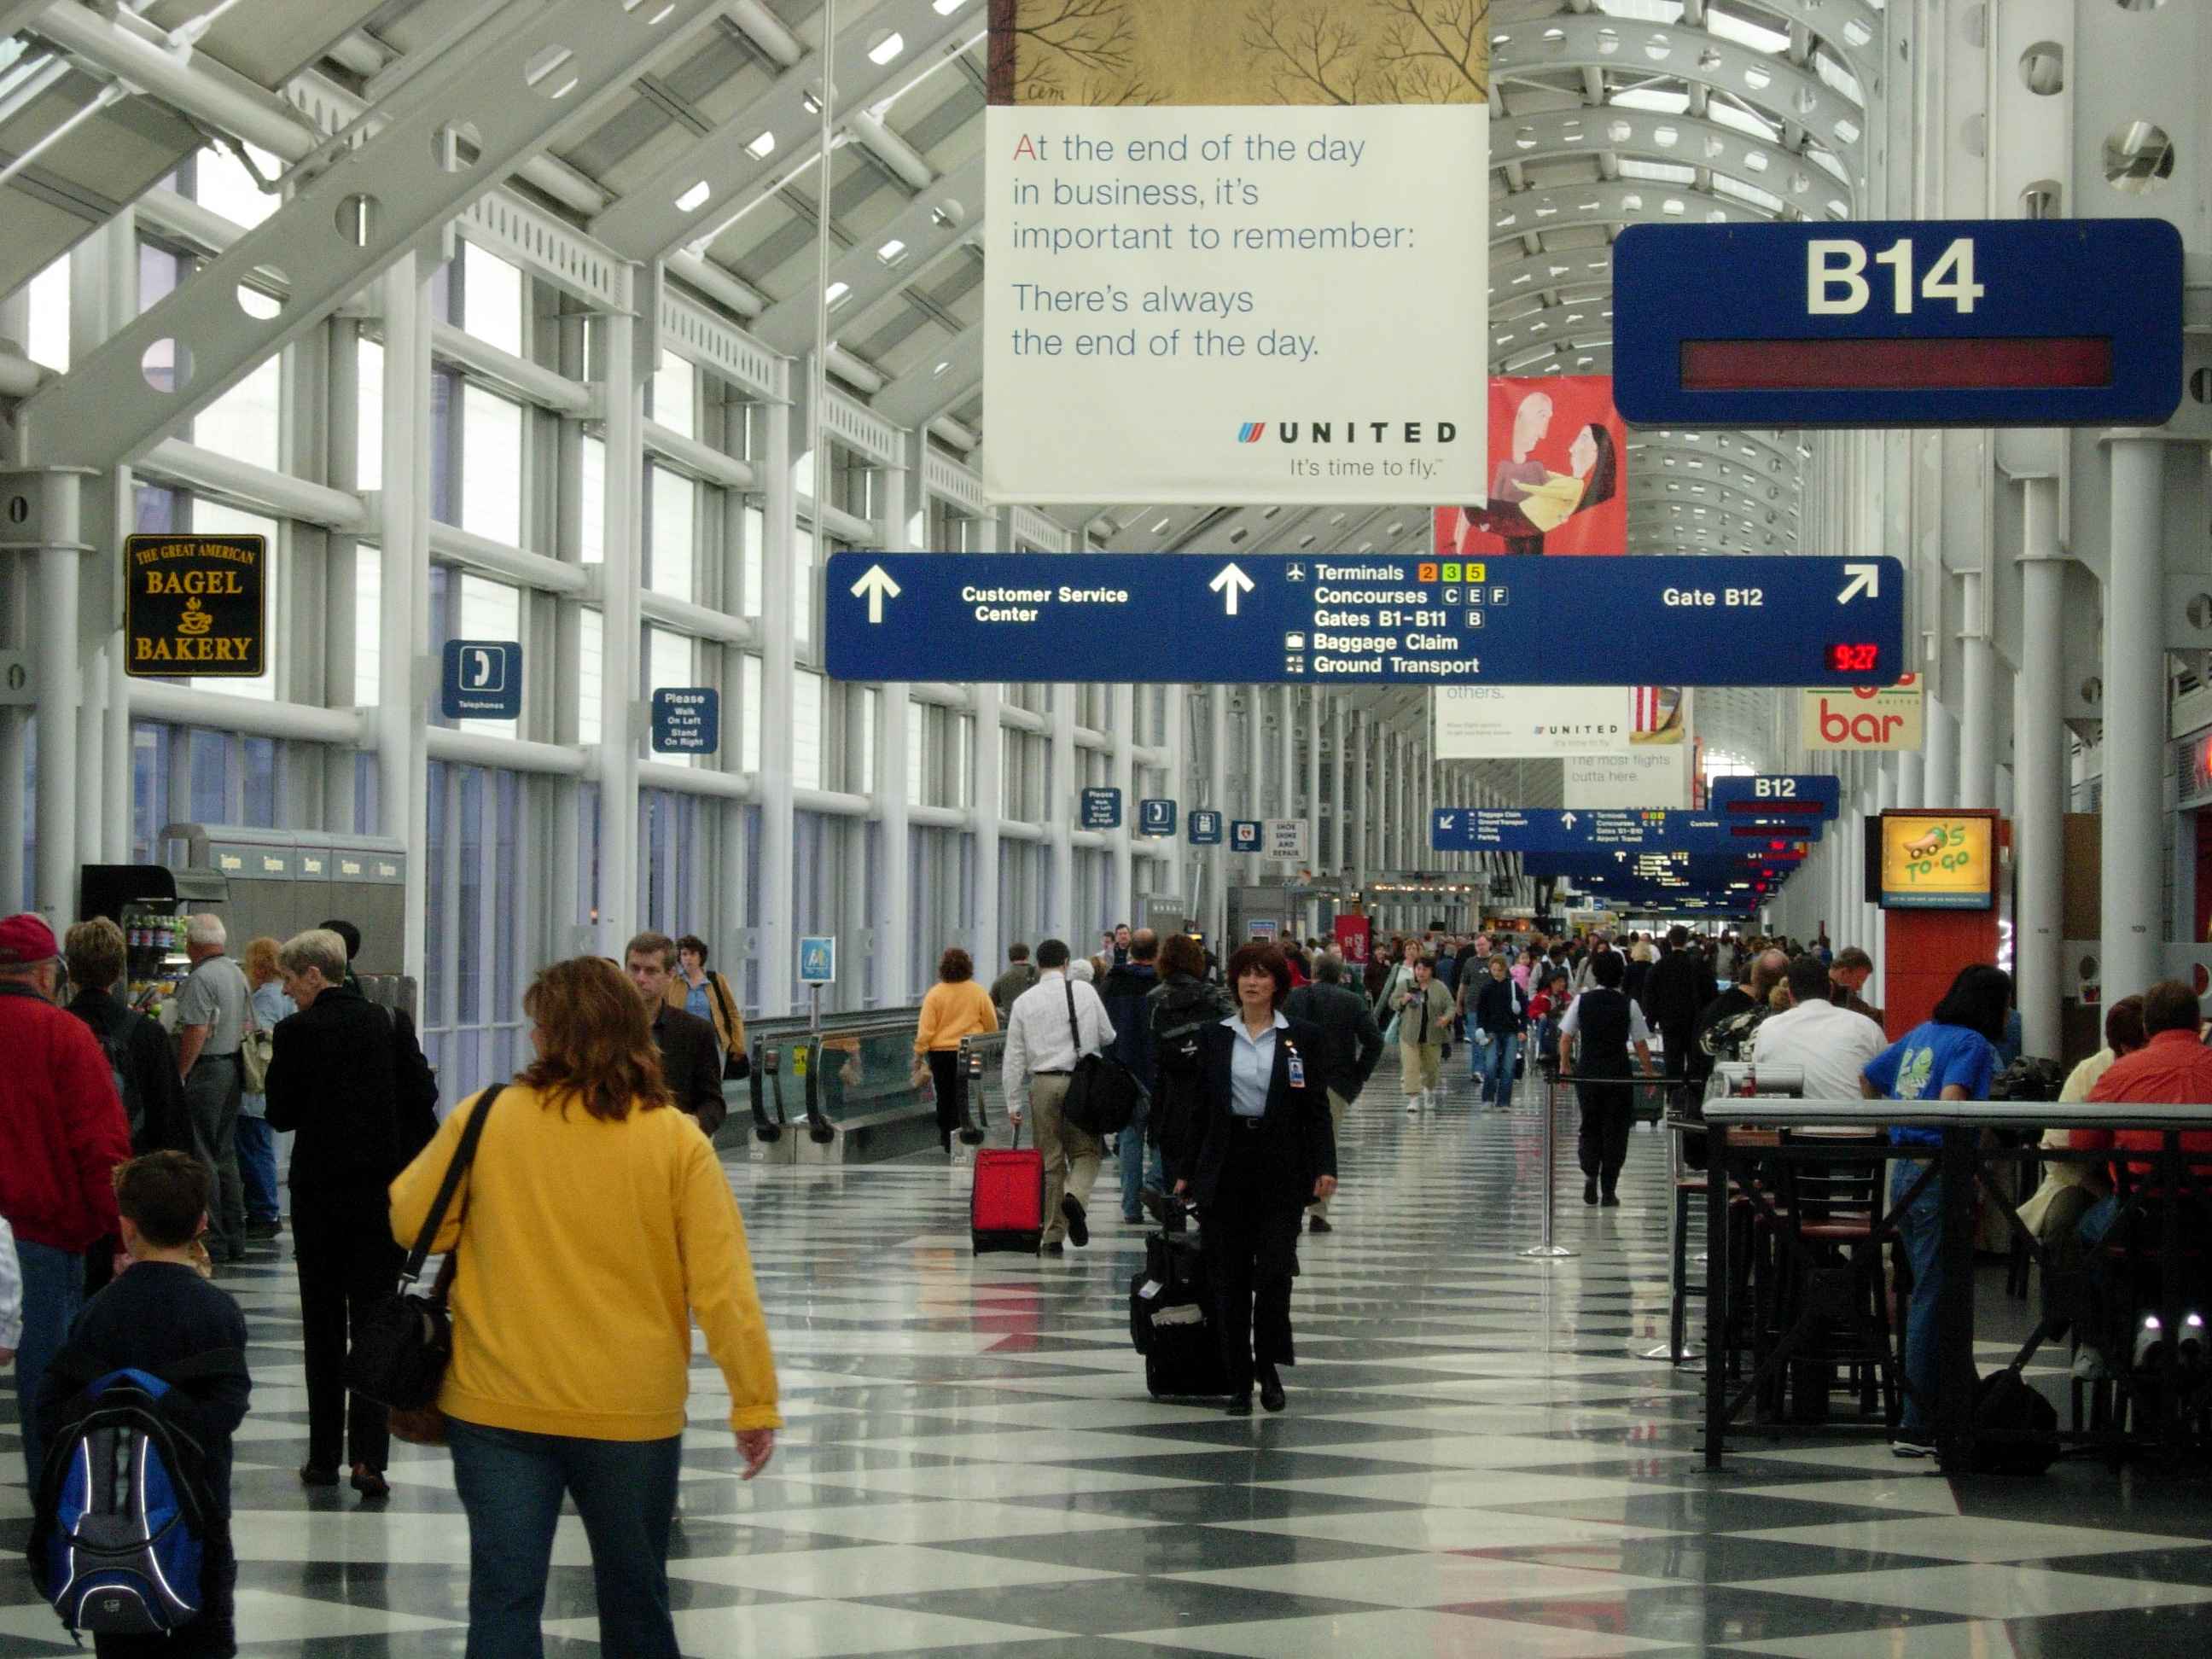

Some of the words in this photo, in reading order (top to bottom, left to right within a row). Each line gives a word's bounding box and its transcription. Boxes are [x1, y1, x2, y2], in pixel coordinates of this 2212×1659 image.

[1013, 135, 1049, 160] At
[1063, 134, 1114, 161] the
[1128, 134, 1187, 161] end
[1201, 133, 1234, 161] of
[1245, 134, 1295, 161] the
[1307, 134, 1365, 171] day
[1013, 179, 1039, 206] in
[1055, 178, 1206, 210] business,
[1215, 178, 1259, 206] it's
[1013, 224, 1173, 255] important
[1189, 224, 1220, 249] to
[1234, 222, 1414, 249] remember:
[1807, 239, 1984, 315] B14
[1012, 284, 1128, 312] There's
[1143, 286, 1254, 319] always
[1012, 329, 1062, 356] the
[1075, 329, 1136, 356] end
[1149, 329, 1182, 356] of
[1195, 329, 1245, 356] the
[1257, 329, 1319, 362] day.
[1279, 422, 1457, 444] UNITED
[1290, 459, 1320, 476] It's
[1329, 459, 1374, 476] time
[1382, 459, 1403, 476] to
[137, 550, 160, 565] THE
[160, 544, 195, 558] GREAT
[199, 544, 255, 565] AMERICAN
[1316, 563, 1405, 581] Terminals
[1423, 565, 1434, 580] 2
[1447, 565, 1458, 580] 3
[1470, 565, 1481, 580] 5
[146, 570, 243, 594] BAGEL
[962, 585, 1051, 603] Customer
[1058, 585, 1128, 603] Service
[1315, 586, 1428, 603] Concourses
[1446, 587, 1458, 603] C
[1470, 587, 1481, 603] E
[1494, 587, 1505, 603] F
[1663, 588, 1715, 607] Gate
[1725, 588, 1763, 606] B12
[975, 605, 1039, 623] Center
[1315, 610, 1371, 627] Gates
[1379, 610, 1447, 626] B1-B11
[1470, 611, 1481, 626] B
[135, 637, 253, 661] BAKERY
[1314, 633, 1398, 653] Baggage
[1406, 633, 1458, 650] Claim
[1314, 656, 1383, 674] Ground
[1391, 656, 1479, 676] Transport
[1835, 643, 1878, 670] 9:27
[665, 692, 705, 705] Please
[1447, 685, 1505, 700] others.
[667, 716, 680, 725] On
[683, 716, 701, 725] Left
[674, 707, 696, 716] Walk
[1819, 698, 1904, 743] bar
[671, 728, 697, 738] Stand
[1550, 725, 1618, 735] UNITED
[665, 737, 678, 747] On
[679, 737, 704, 748] Right
[1633, 754, 1671, 768] flights
[1755, 778, 1796, 797] B12
